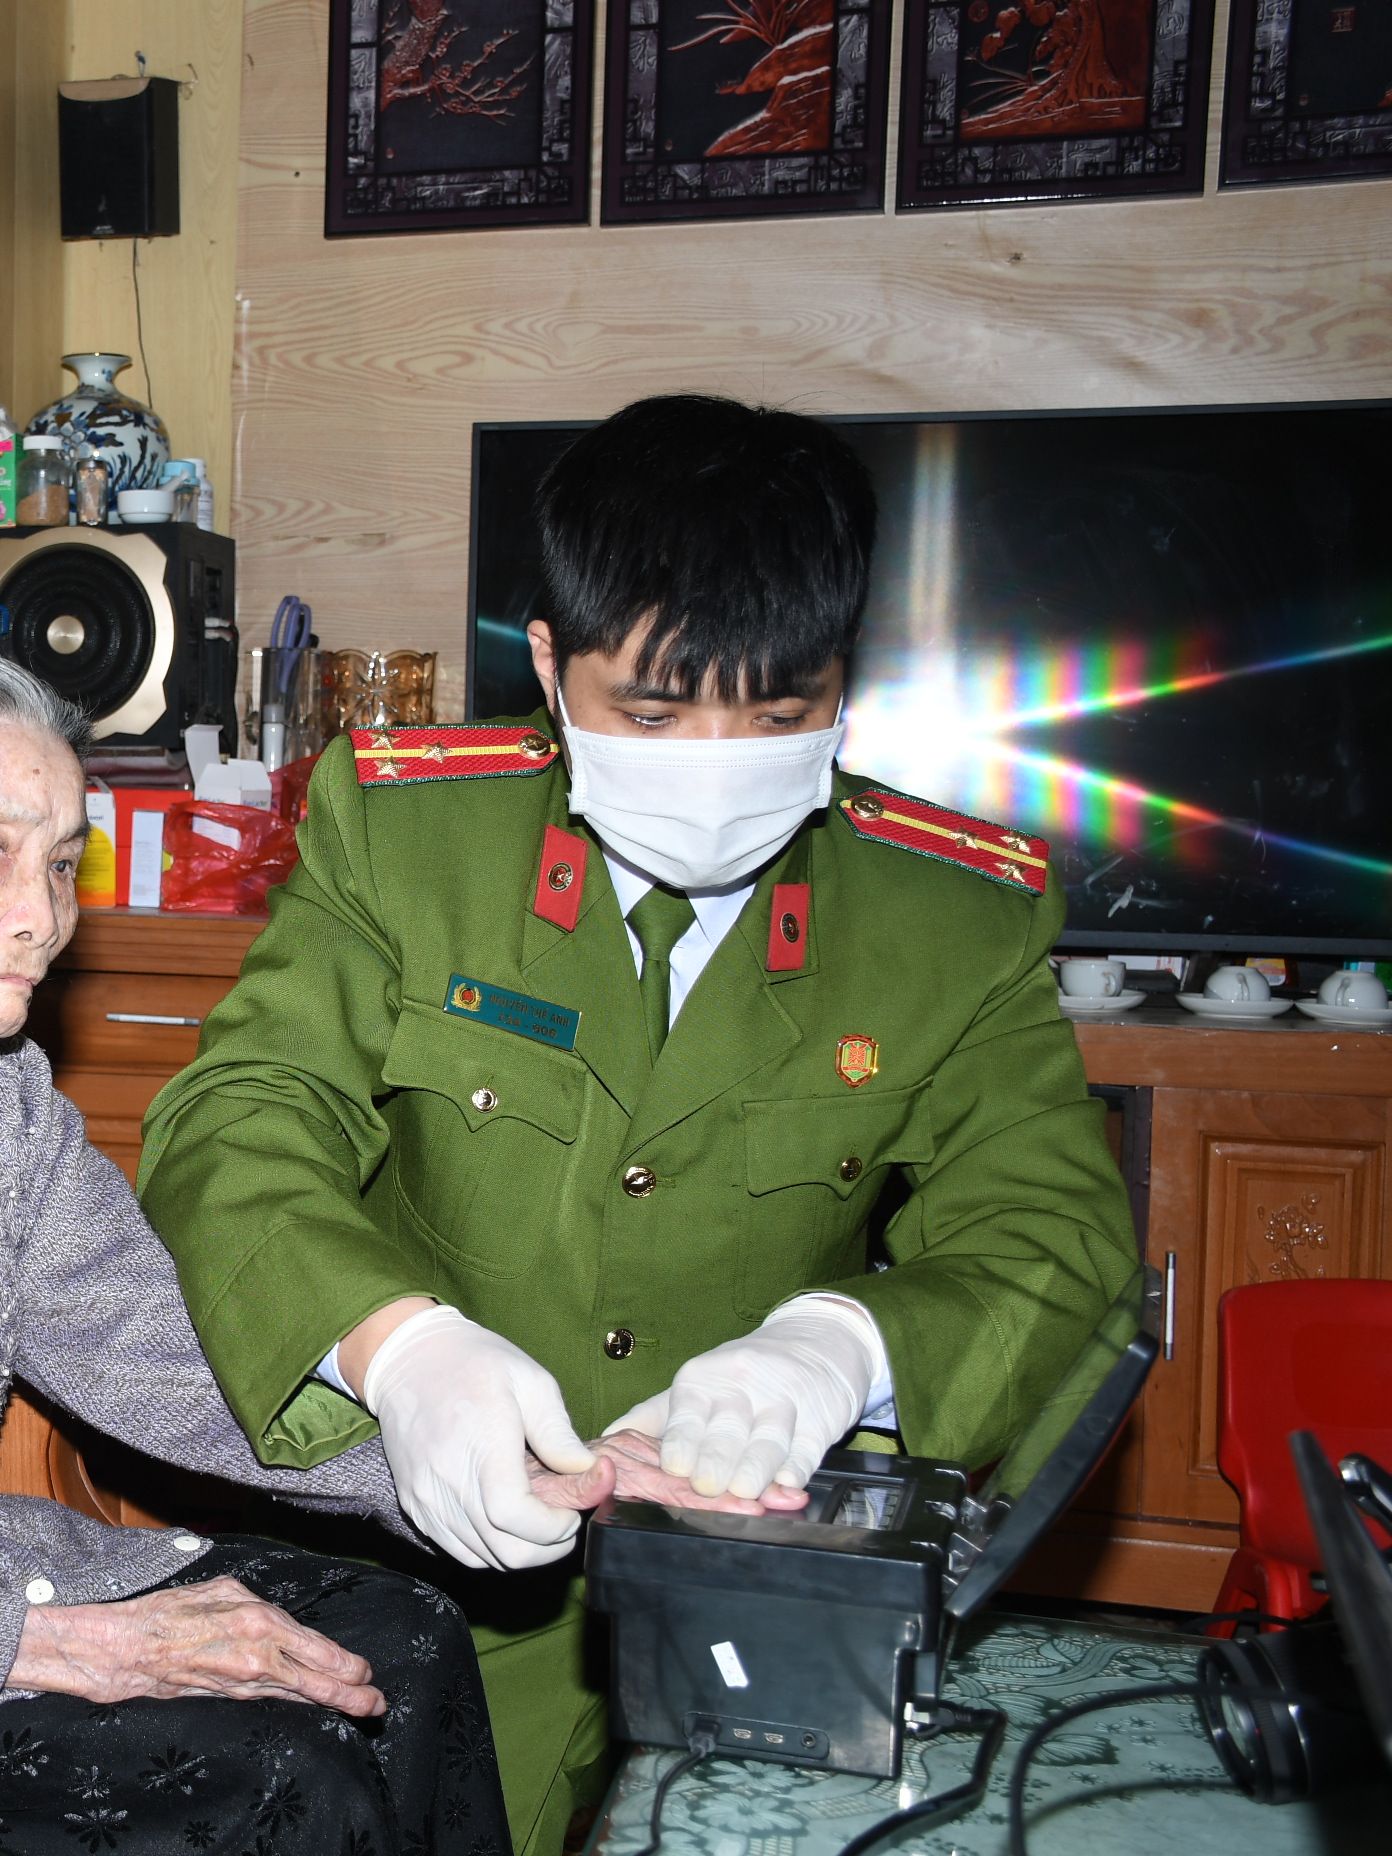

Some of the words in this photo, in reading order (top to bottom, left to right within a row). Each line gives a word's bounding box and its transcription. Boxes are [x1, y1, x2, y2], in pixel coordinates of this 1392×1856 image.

[490, 994, 528, 1014] NGUYỄN
[530, 1006, 549, 1020] THẾ
[550, 1013, 570, 1027] ANH
[533, 1023, 557, 1039] 606
